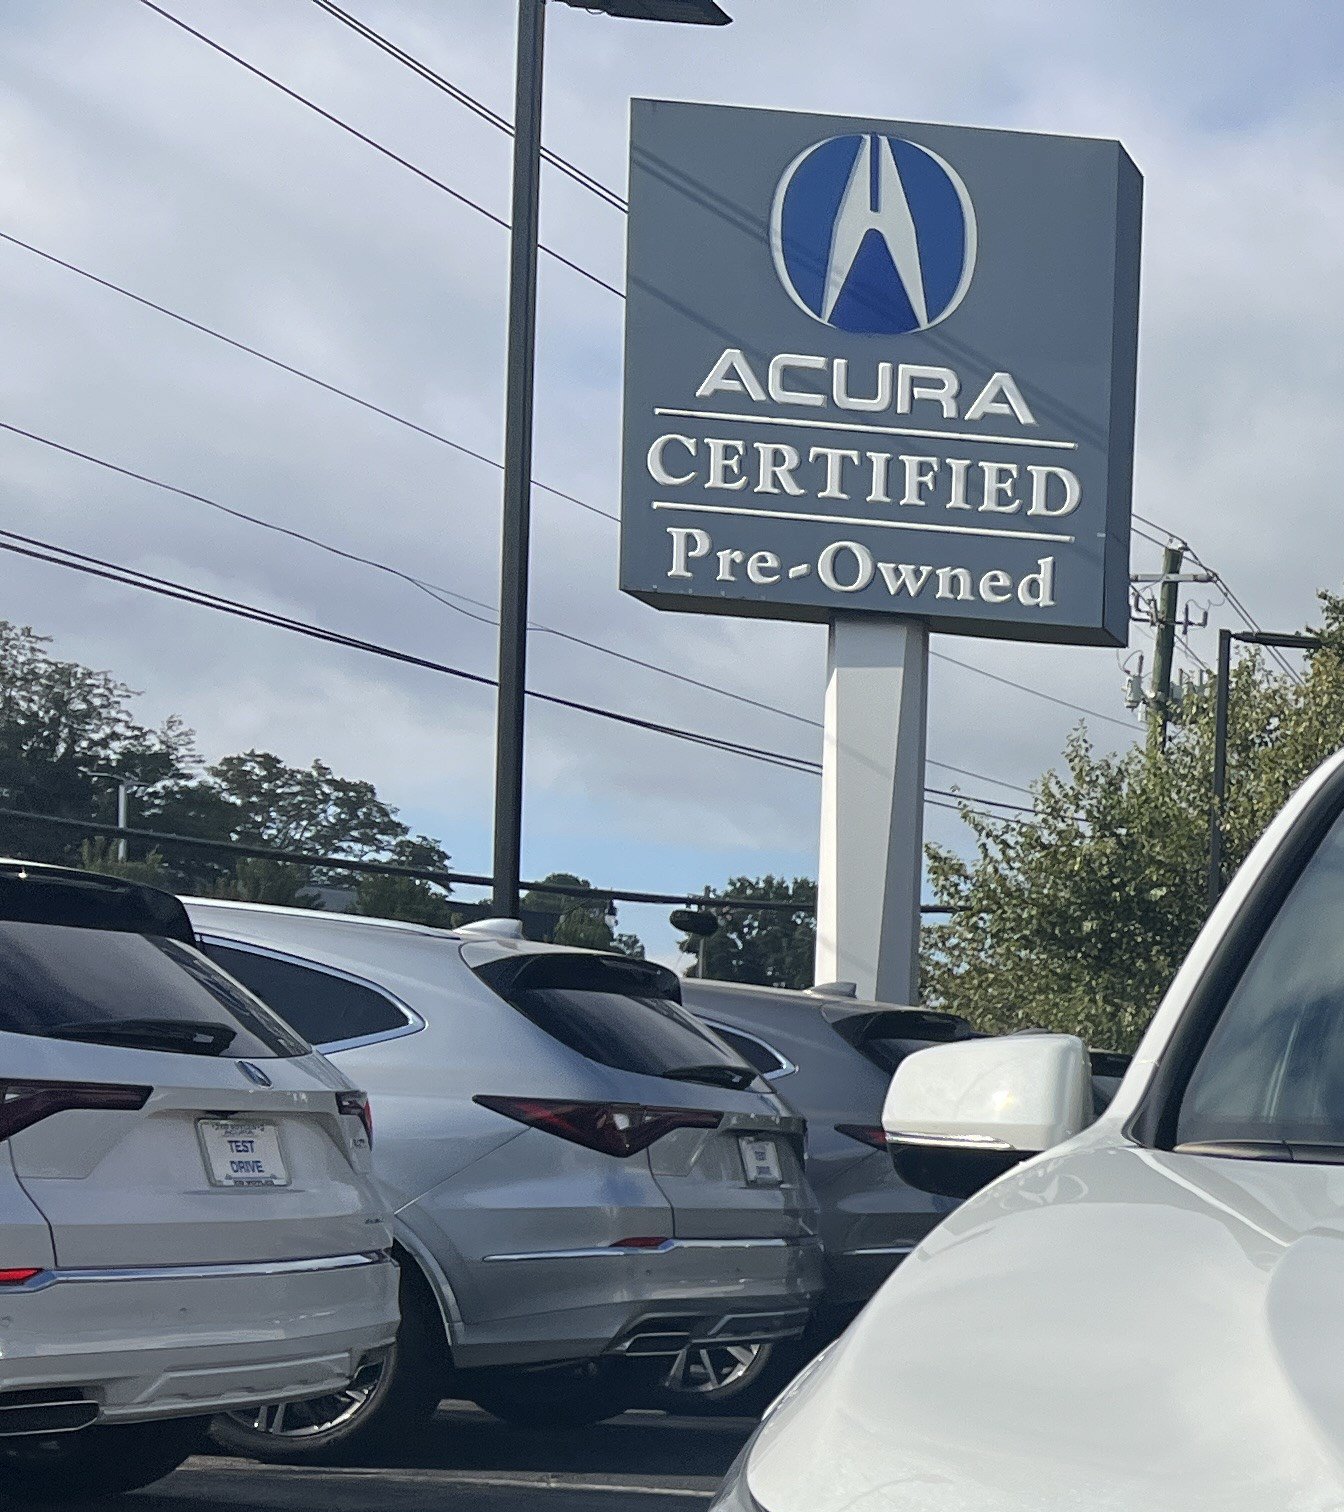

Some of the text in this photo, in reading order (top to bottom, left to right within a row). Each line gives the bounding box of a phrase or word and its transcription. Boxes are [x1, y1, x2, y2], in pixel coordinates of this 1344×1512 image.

[696, 348, 1039, 426] ACURA
[647, 434, 1082, 517] CERTIFIED
[666, 527, 1057, 608] Pre-Owned
[227, 1140, 255, 1153] TEST
[229, 1160, 265, 1173] DRIVE
